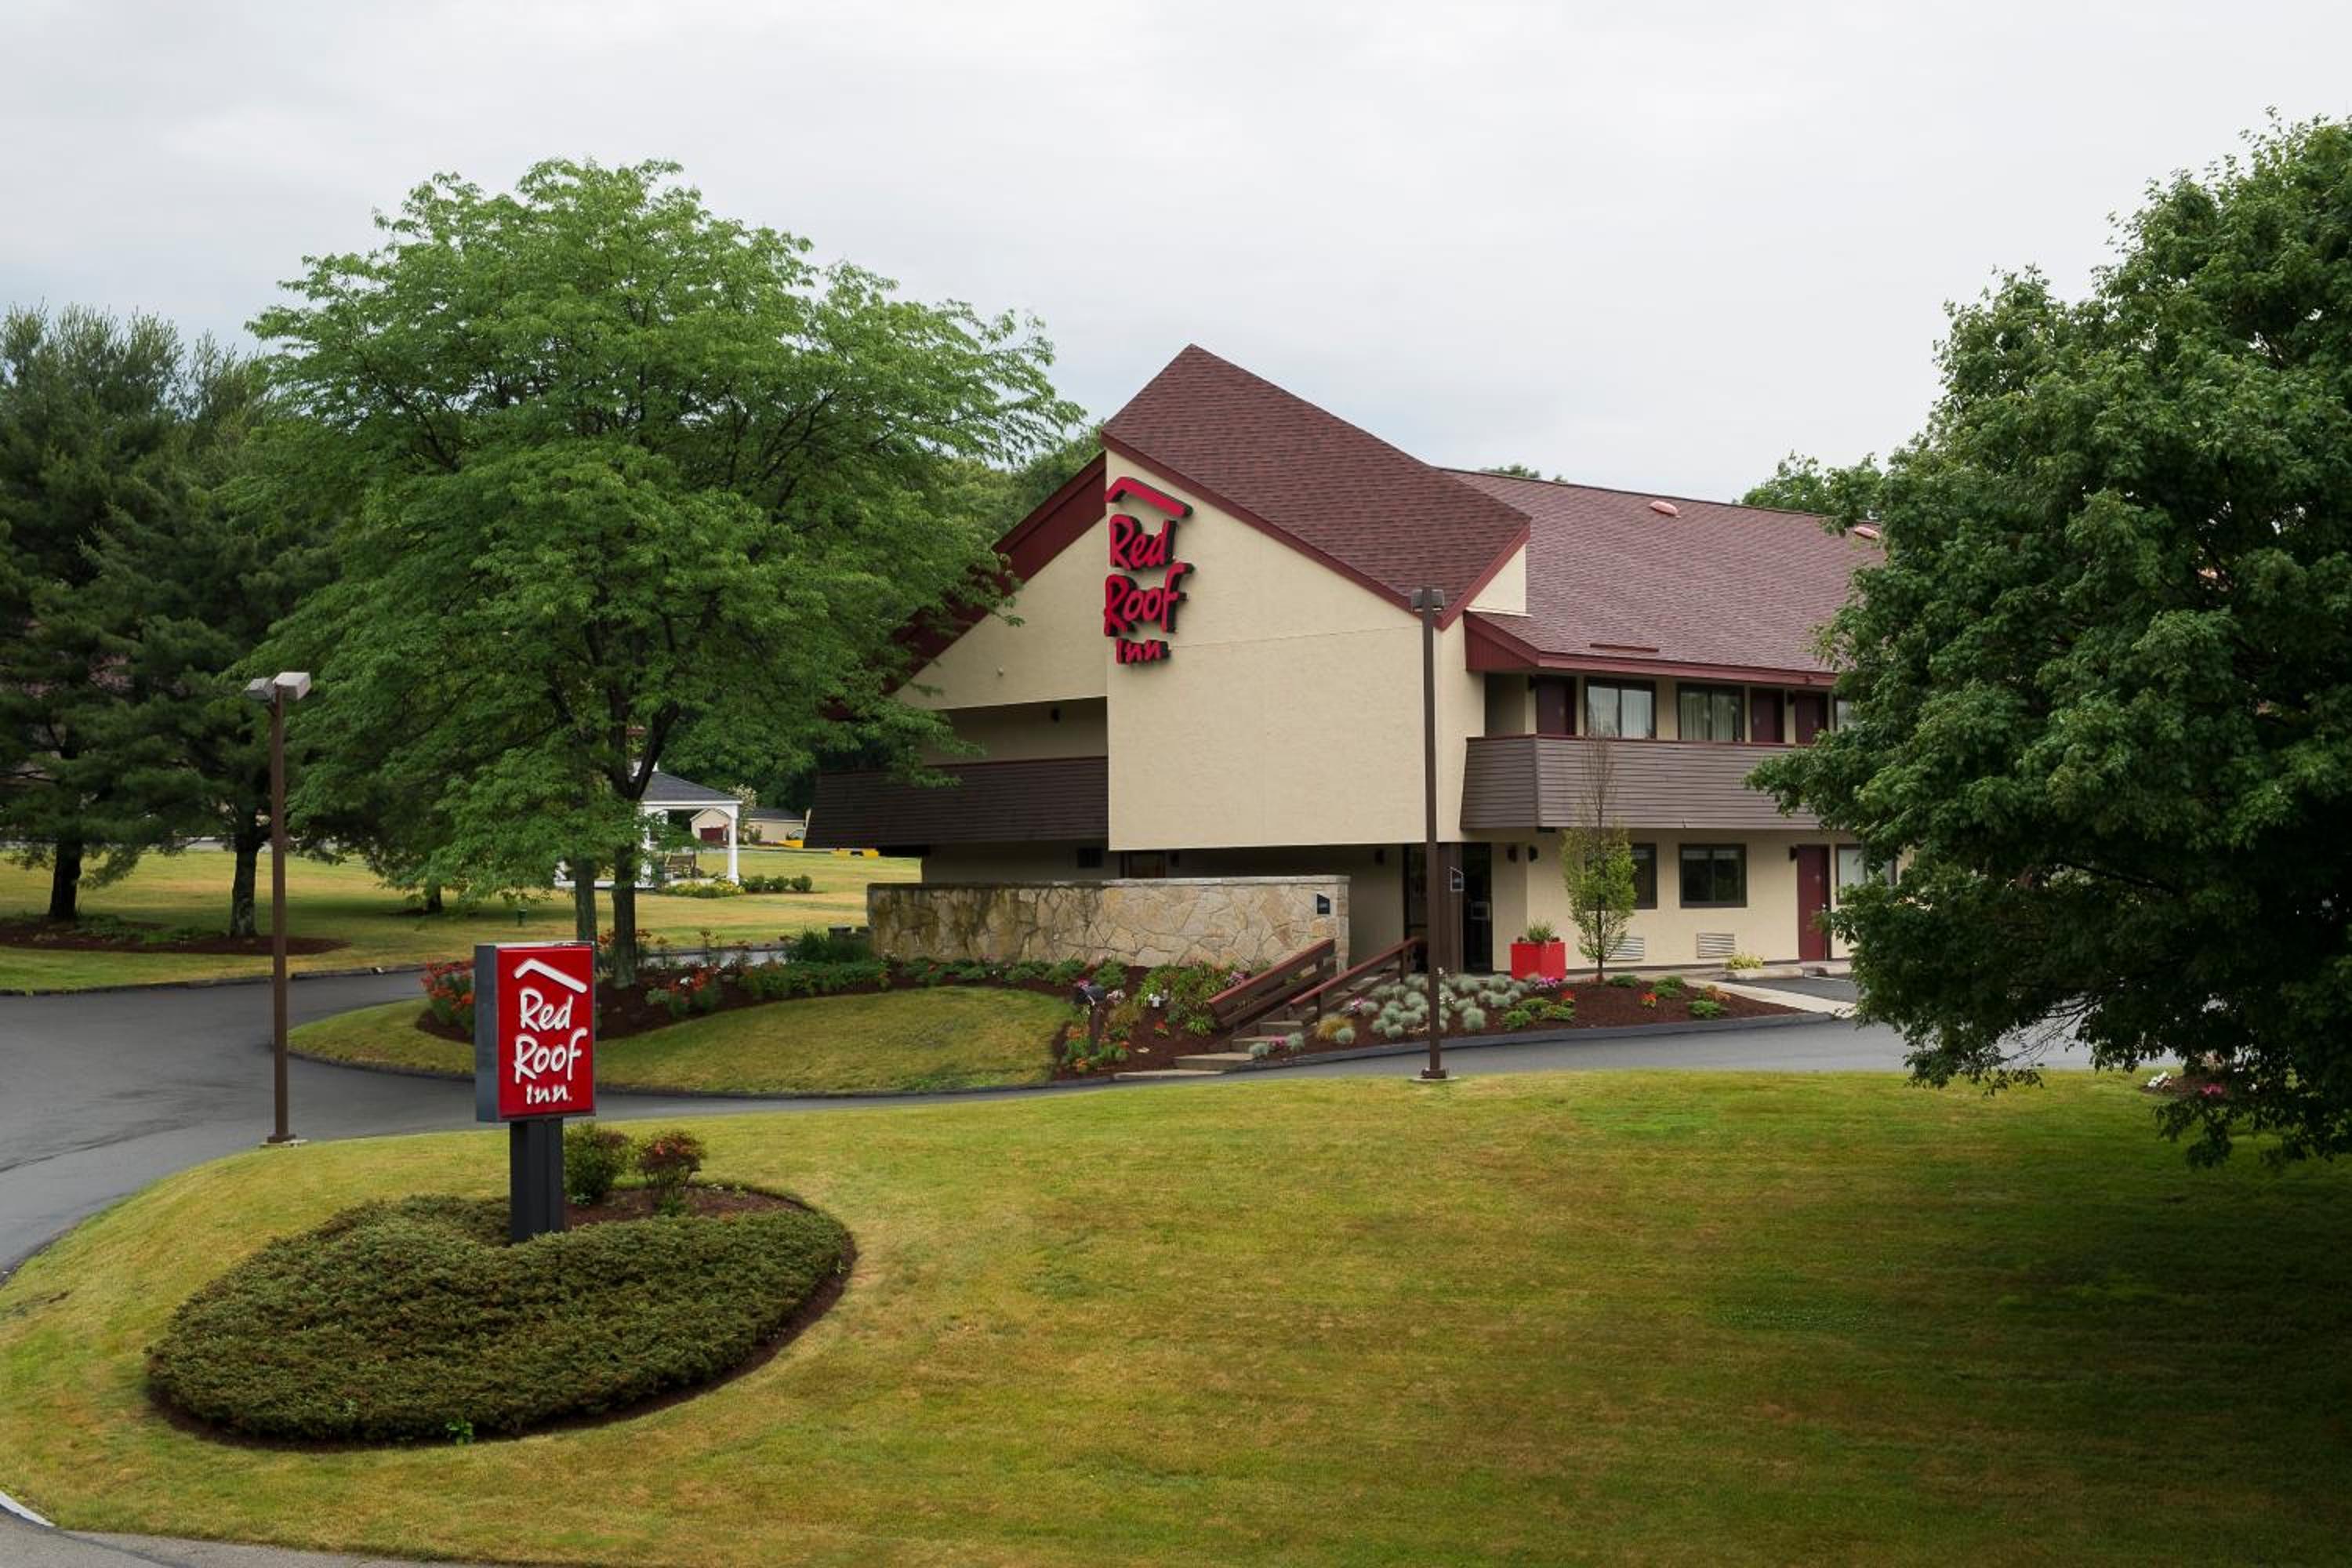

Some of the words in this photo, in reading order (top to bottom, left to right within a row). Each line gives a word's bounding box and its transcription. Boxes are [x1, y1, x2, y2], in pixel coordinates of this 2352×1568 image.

[1109, 514, 1177, 570] Red
[1104, 562, 1193, 636] Roof
[1116, 639, 1170, 664] Inn
[520, 988, 573, 1032] Red
[514, 1028, 588, 1083] Roof
[526, 1084, 571, 1104] Inn
